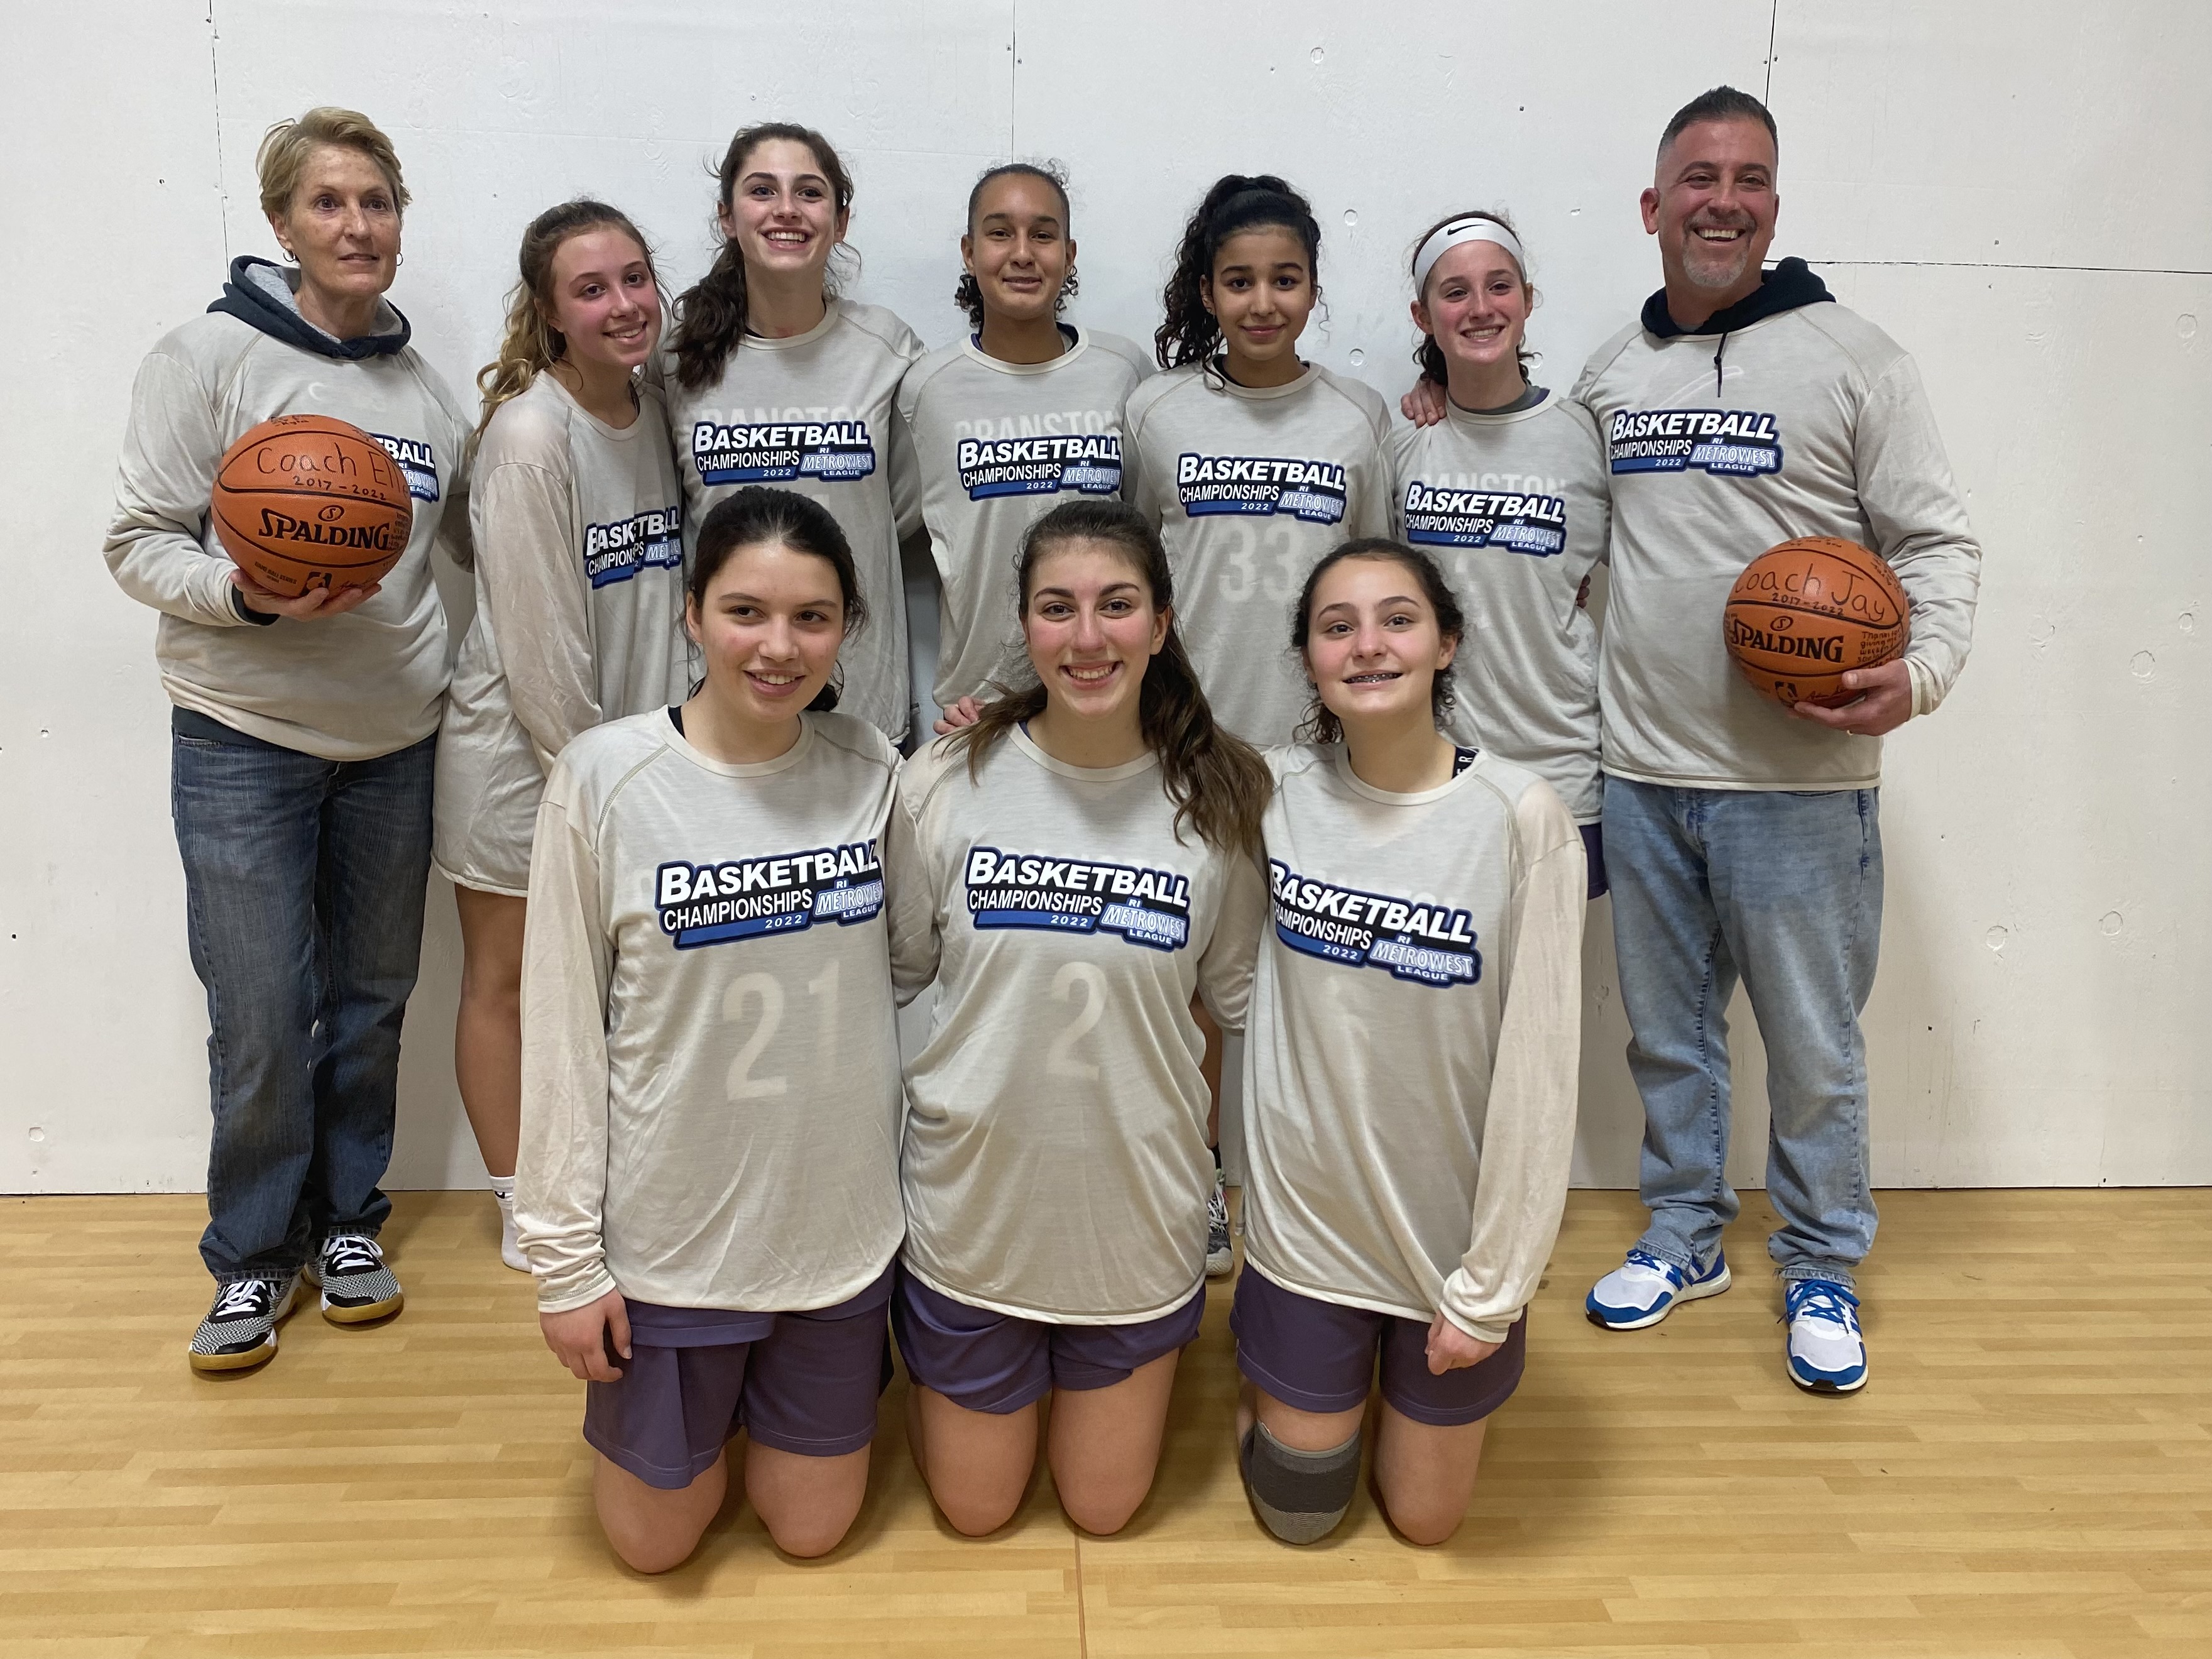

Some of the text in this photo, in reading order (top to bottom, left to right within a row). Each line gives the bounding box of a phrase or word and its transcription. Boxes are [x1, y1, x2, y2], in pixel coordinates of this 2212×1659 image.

[695, 424, 868, 452] BASKETBALL
[1612, 413, 1775, 441] BASKETBALL
[257, 442, 357, 476] Coach
[697, 450, 800, 471] CHAMPIONSHIPS
[960, 438, 1120, 469] BASKETBALL
[1610, 440, 1692, 460] CHAMPIONSHIPS
[1689, 445, 1776, 468] METROWEST
[763, 469, 791, 477] 2022
[800, 453, 873, 471] METROWEST
[1179, 456, 1345, 490] BASKETBALL
[1655, 459, 1681, 467] 2022
[1711, 463, 1755, 471] LEAGUE
[963, 463, 1061, 488] CHAMPIONSHIPS
[1026, 481, 1053, 490] 2022
[1180, 484, 1280, 503] CHAMPIONSHIPS
[1278, 491, 1344, 517] METROWEST
[1405, 485, 1564, 523] BASKETBALL
[1241, 503, 1269, 511] 2022
[1299, 509, 1332, 520] LEAGUE
[258, 508, 390, 551] SPALDING
[1405, 513, 1494, 534] CHAMPIONSHIPS
[1453, 535, 1481, 543] 2022
[1489, 524, 1562, 549] METROWEST
[1511, 542, 1547, 552] LEAGUE
[1217, 518, 1303, 602] 33
[1771, 592, 1844, 616] 2017-2022
[1831, 570, 1885, 622] Jay
[1731, 618, 1844, 663] SPALDING
[660, 844, 879, 905] BASKETBALL
[836, 880, 847, 889] RI
[968, 851, 1188, 908] BASKETBALL
[664, 888, 813, 931] CHAMPIONSHIPS
[843, 904, 877, 918] LEAGUE
[969, 889, 1103, 916] CHAMPIONSHIPS
[1129, 899, 1141, 907] RI
[1270, 863, 1472, 944] BASKETBALL
[765, 914, 802, 929] 2022
[1051, 915, 1088, 927] 2022
[1101, 904, 1186, 943] METROWEST
[1273, 899, 1373, 950] HAMPIONSHIPS
[1129, 929, 1172, 944] LEAGUE
[1397, 935, 1410, 944] RI
[1322, 944, 1359, 960] 2022
[1368, 939, 1474, 977] METROWEST
[1397, 965, 1449, 981] LEAGUE
[1045, 961, 1109, 1081] 2
